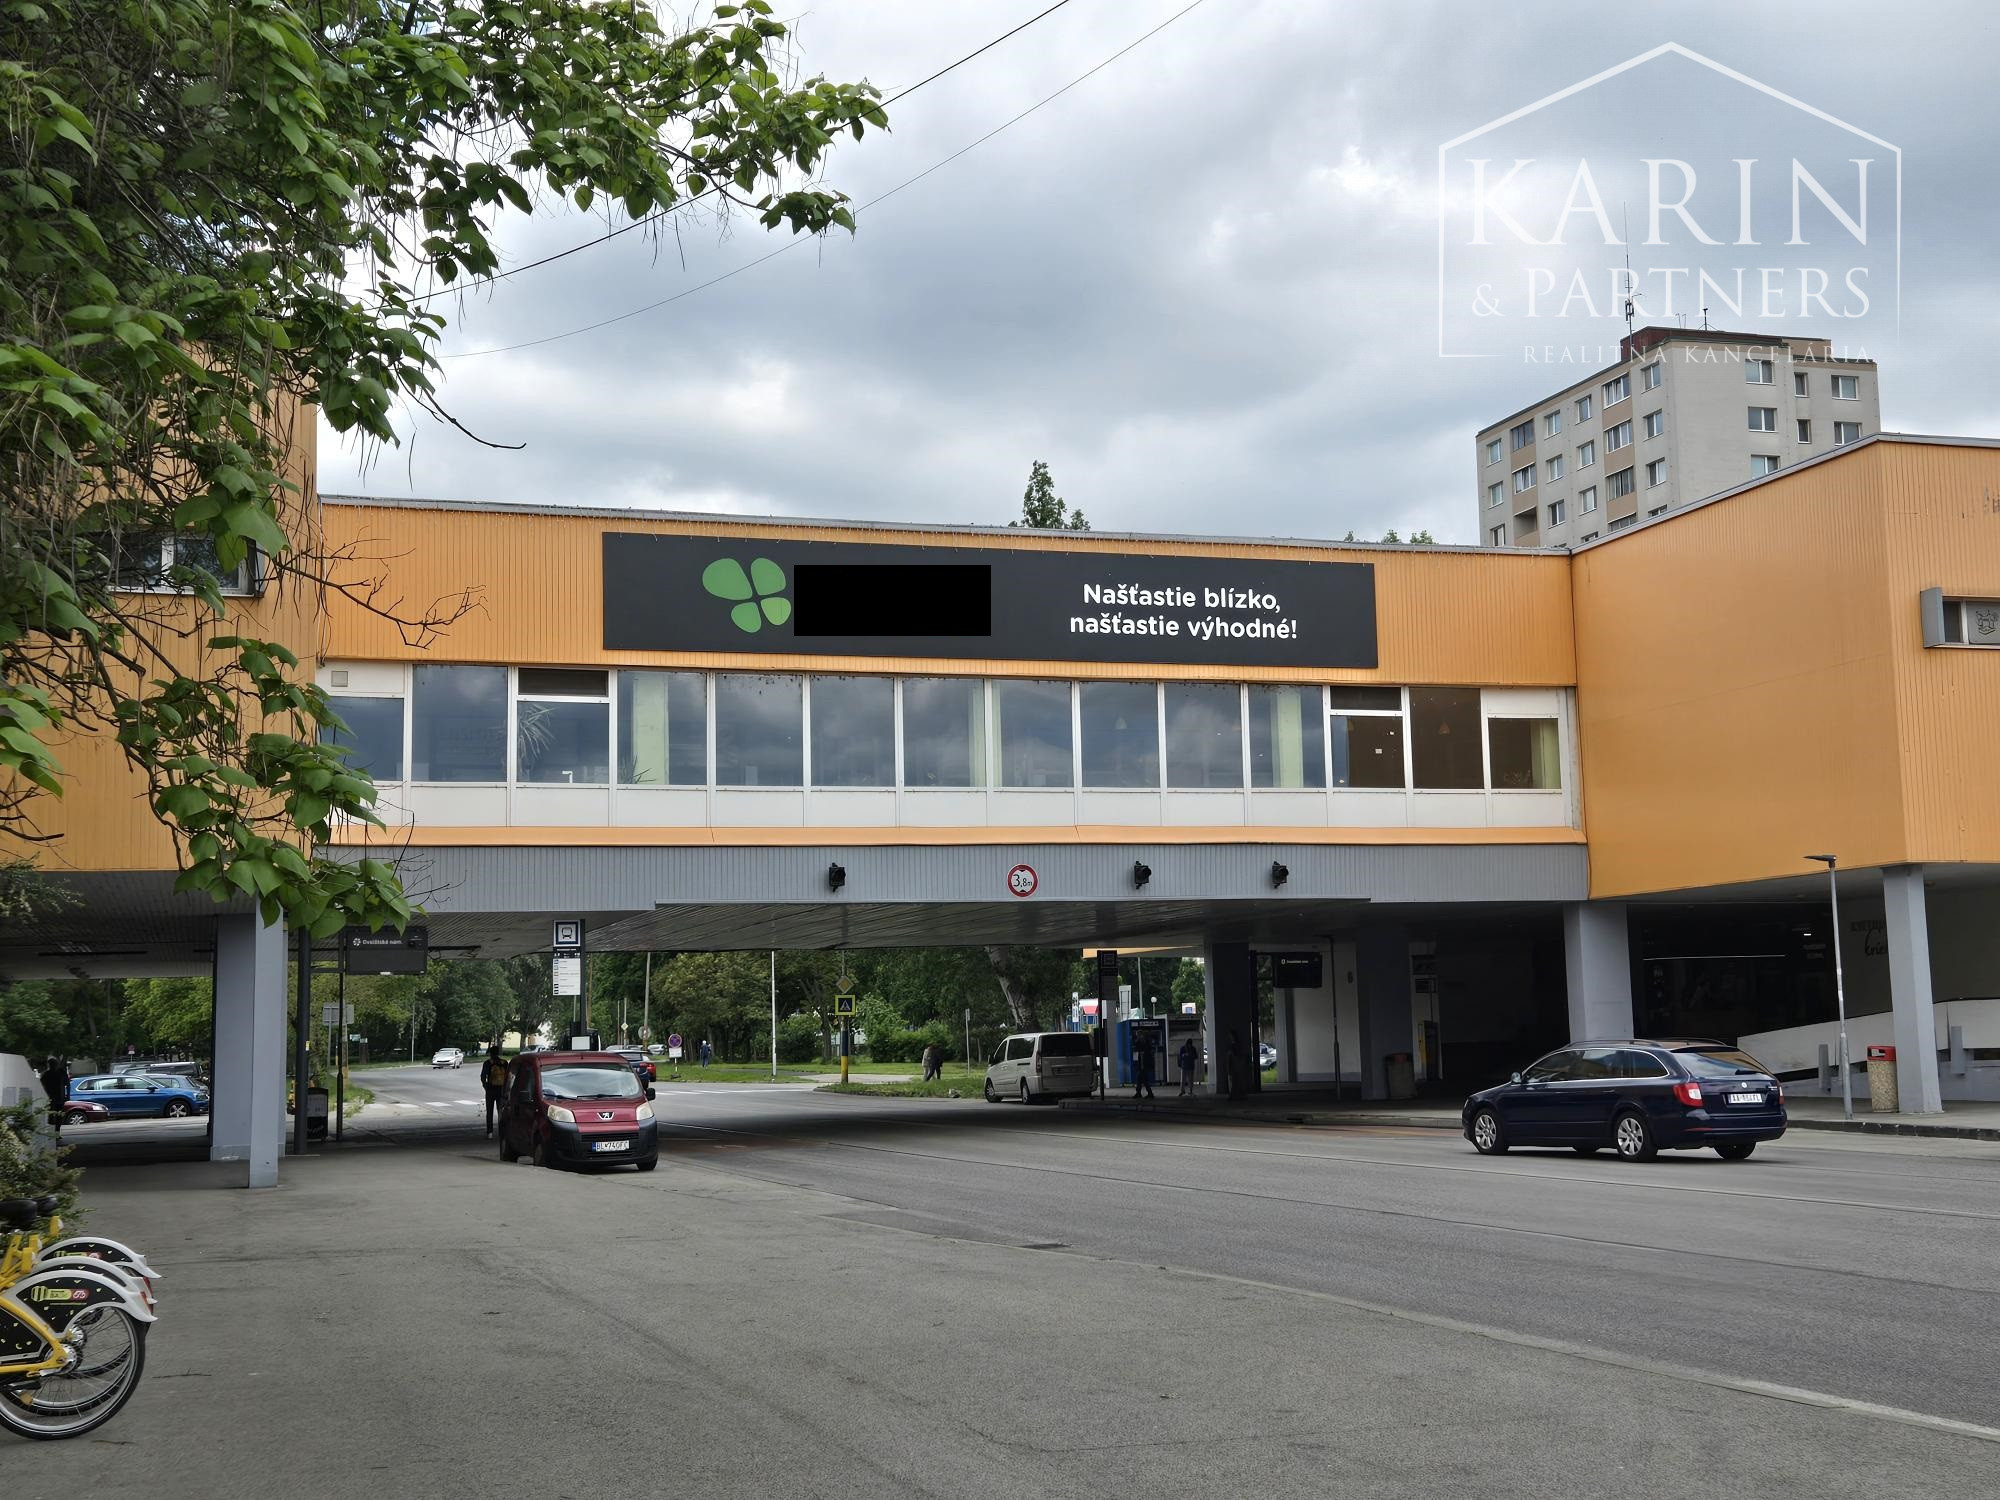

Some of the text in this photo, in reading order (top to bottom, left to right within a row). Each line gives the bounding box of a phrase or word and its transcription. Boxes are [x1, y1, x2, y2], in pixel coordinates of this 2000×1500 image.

[1083, 583, 1281, 613] Našťastie blízko,
[1070, 612, 1298, 641] našťastie výhodné!
